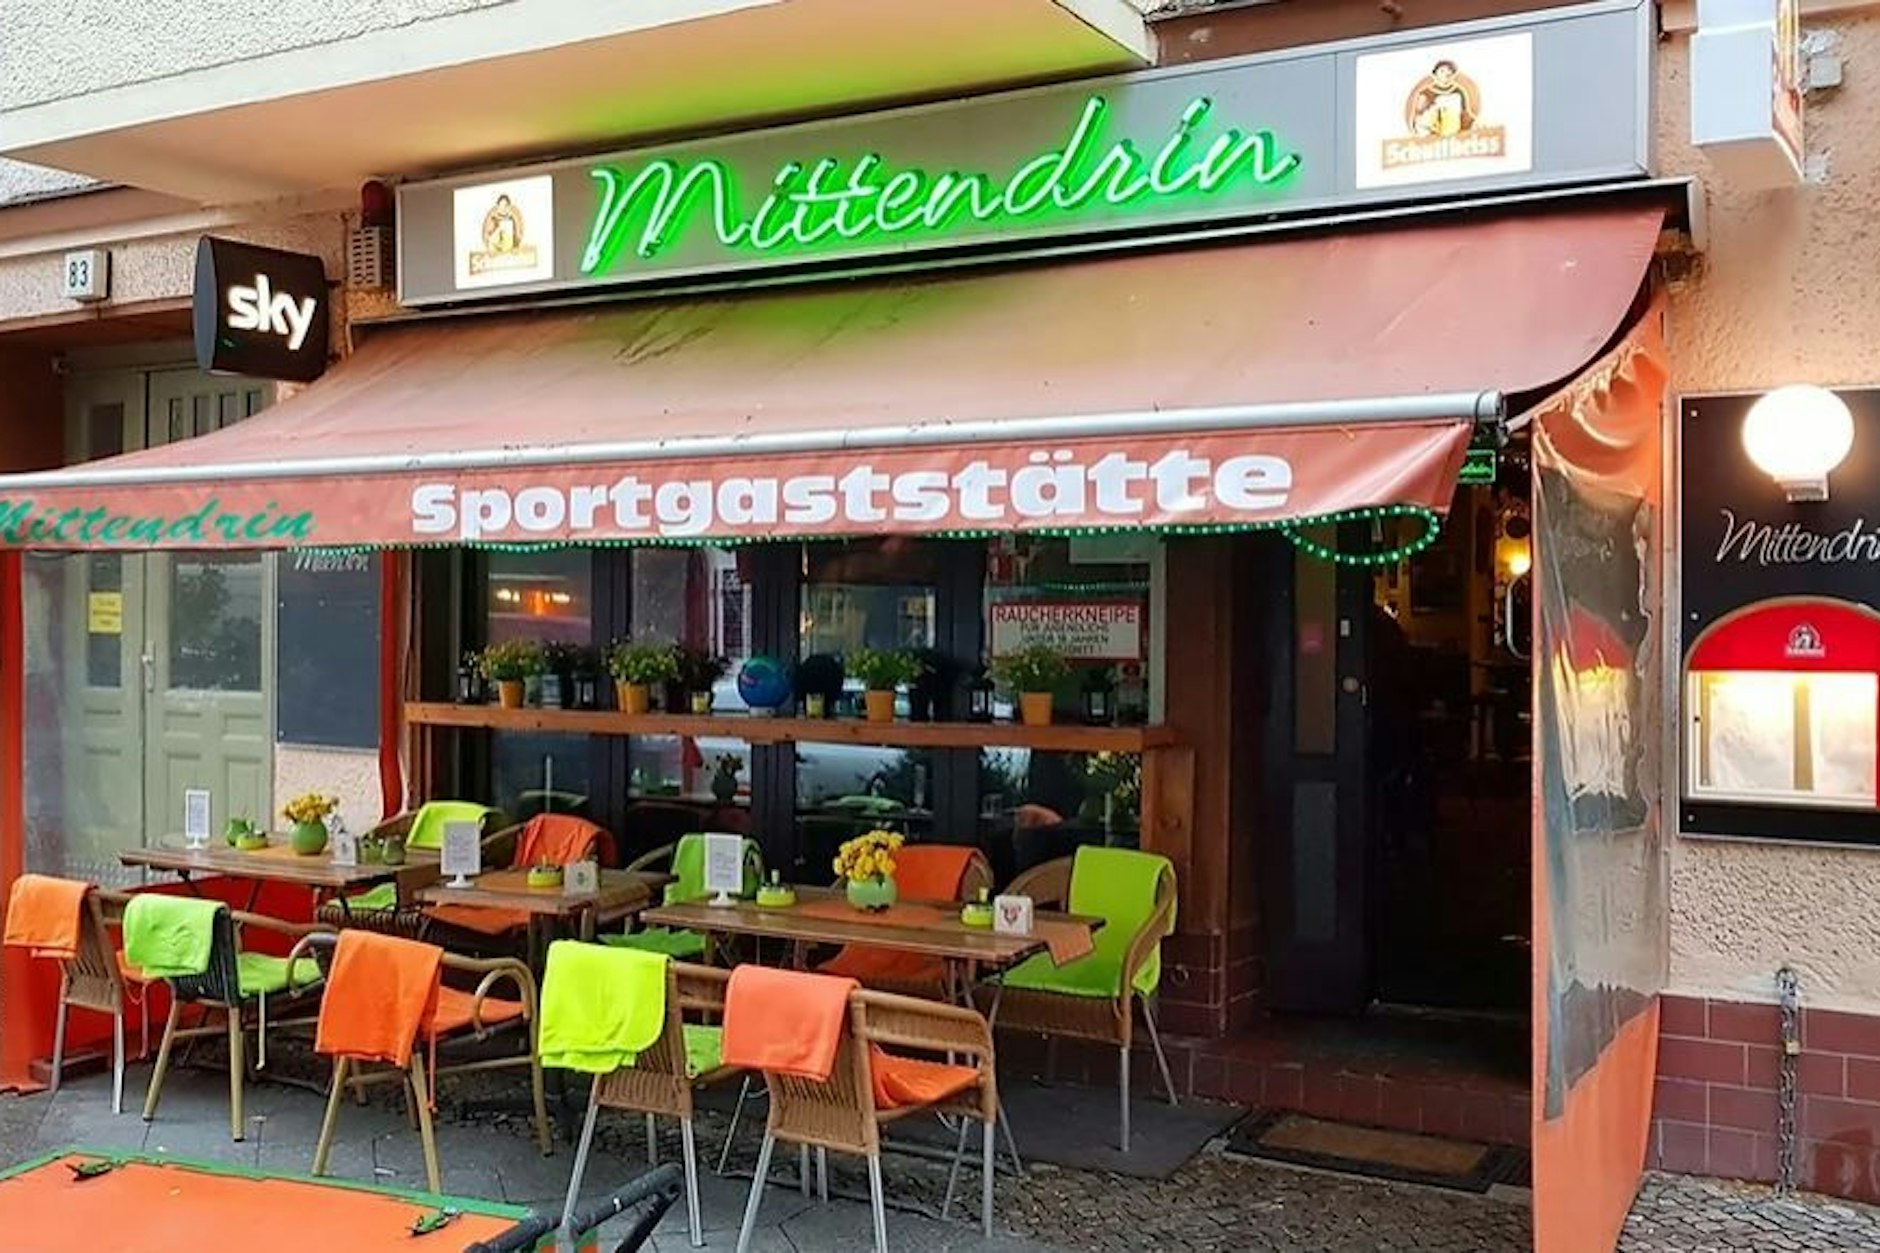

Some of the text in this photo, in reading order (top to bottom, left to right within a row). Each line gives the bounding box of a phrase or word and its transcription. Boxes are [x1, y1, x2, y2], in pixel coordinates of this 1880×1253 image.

[581, 96, 1301, 274] Mittendrin
[68, 259, 89, 288] 83
[227, 273, 318, 351] sky
[994, 604, 1137, 624] RAUCHERKNEIPE
